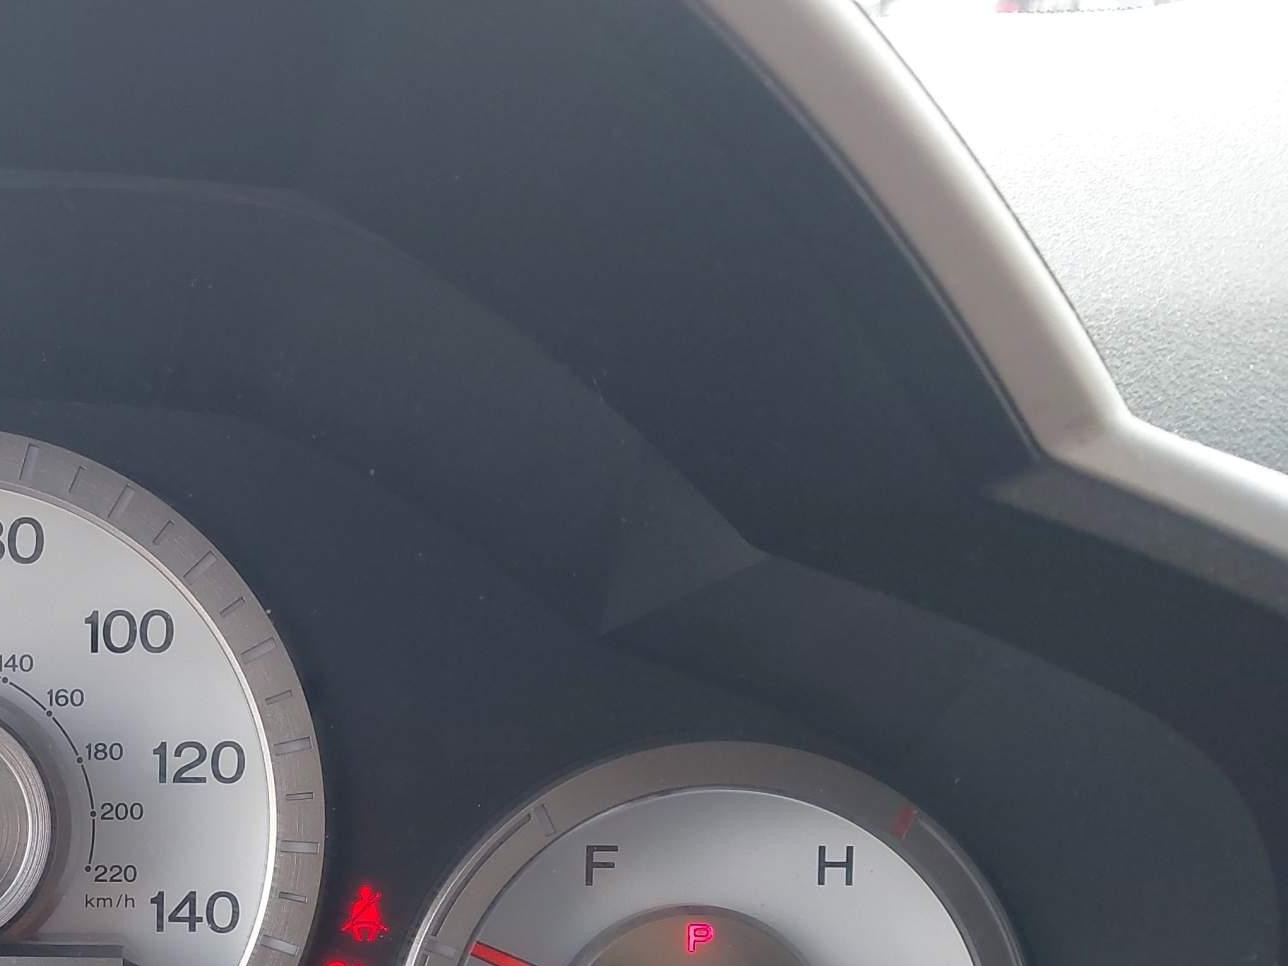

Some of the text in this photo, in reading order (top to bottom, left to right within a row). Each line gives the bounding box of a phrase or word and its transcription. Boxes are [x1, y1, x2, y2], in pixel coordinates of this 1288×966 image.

[84, 609, 175, 654] 100
[47, 689, 84, 707] 160
[86, 743, 123, 761] 180
[153, 741, 246, 785] 120
[101, 803, 143, 821] 200
[94, 865, 137, 883] 220
[585, 845, 619, 887] F
[816, 845, 854, 887] H
[85, 894, 135, 909] km/h
[150, 891, 240, 933] 140
[686, 923, 713, 953] P
